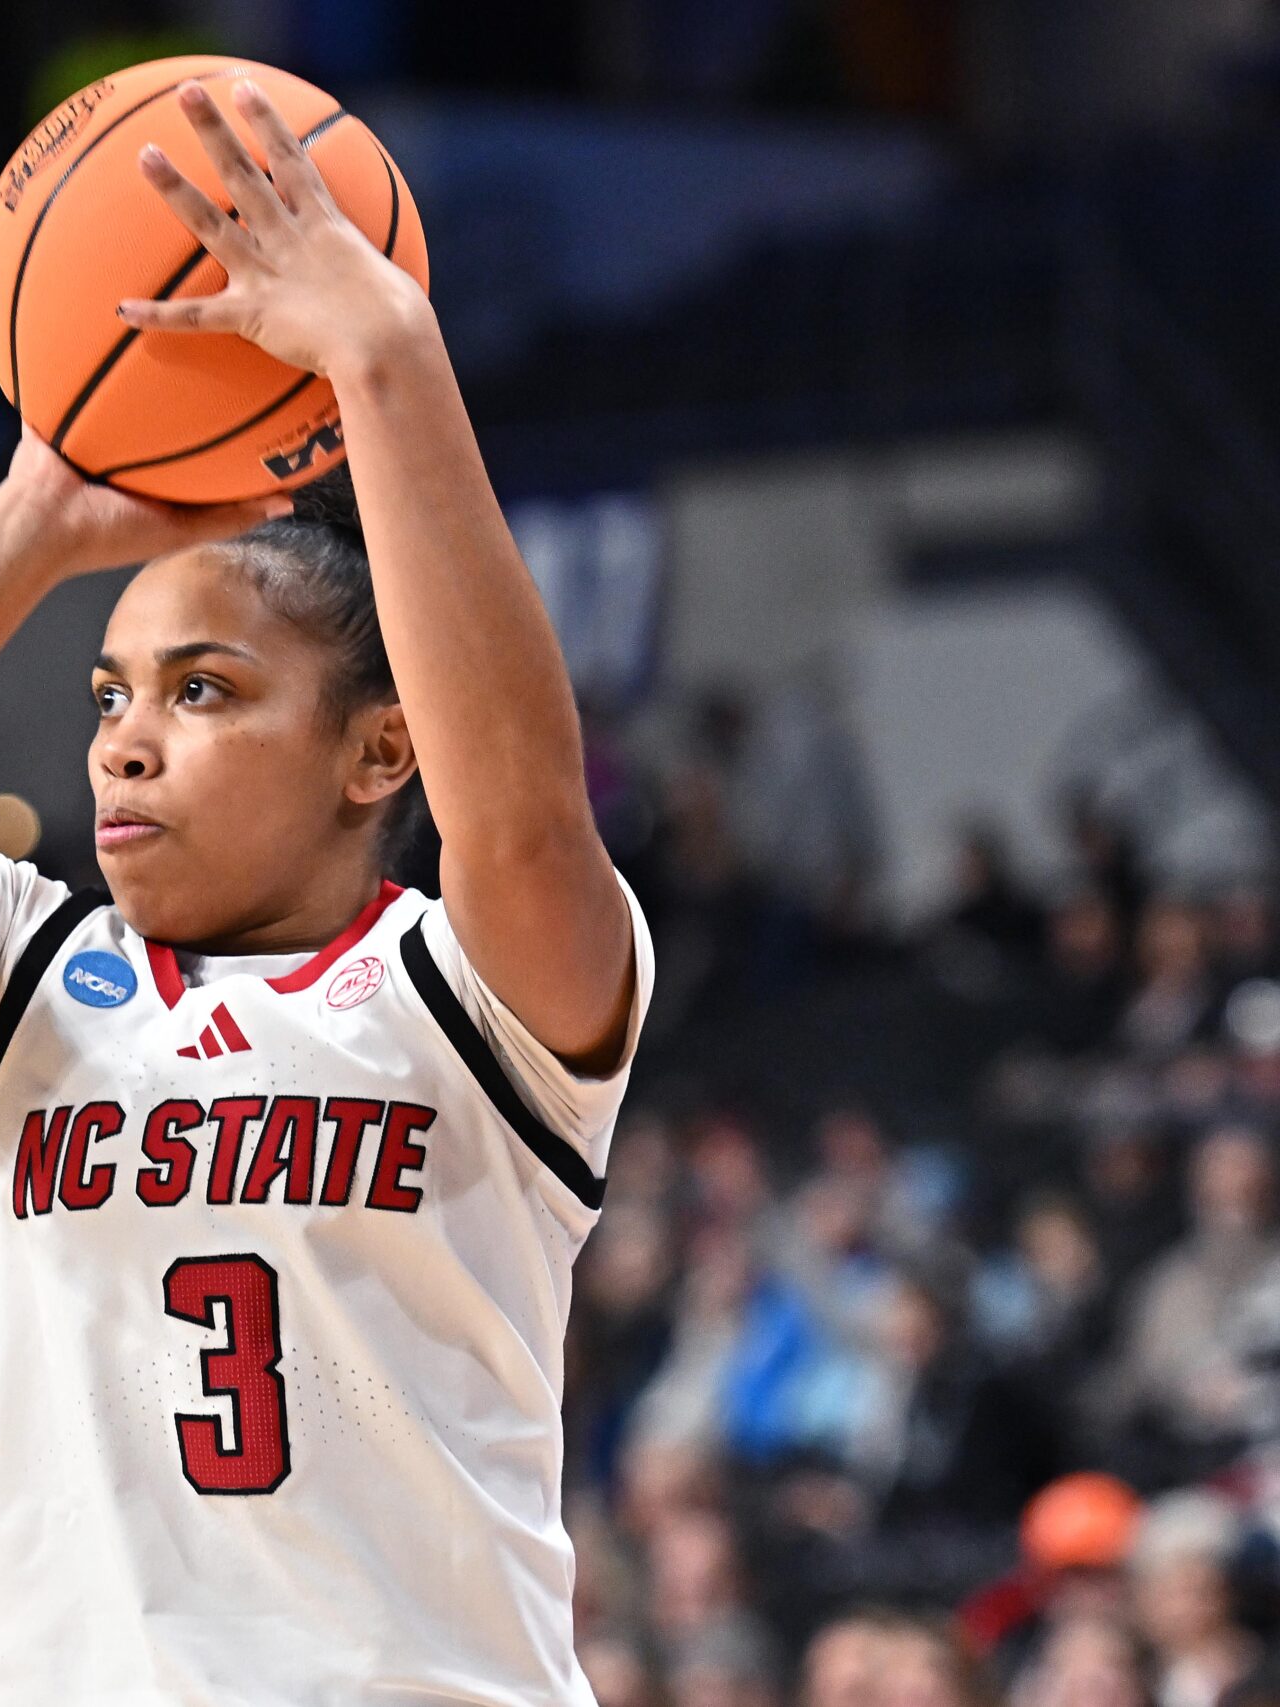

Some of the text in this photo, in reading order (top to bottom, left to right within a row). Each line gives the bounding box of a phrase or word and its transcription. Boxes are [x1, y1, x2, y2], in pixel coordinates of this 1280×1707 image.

[69, 967, 128, 1001] NCAA
[12, 1095, 437, 1220] NC STATE
[162, 1252, 291, 1495] 3
